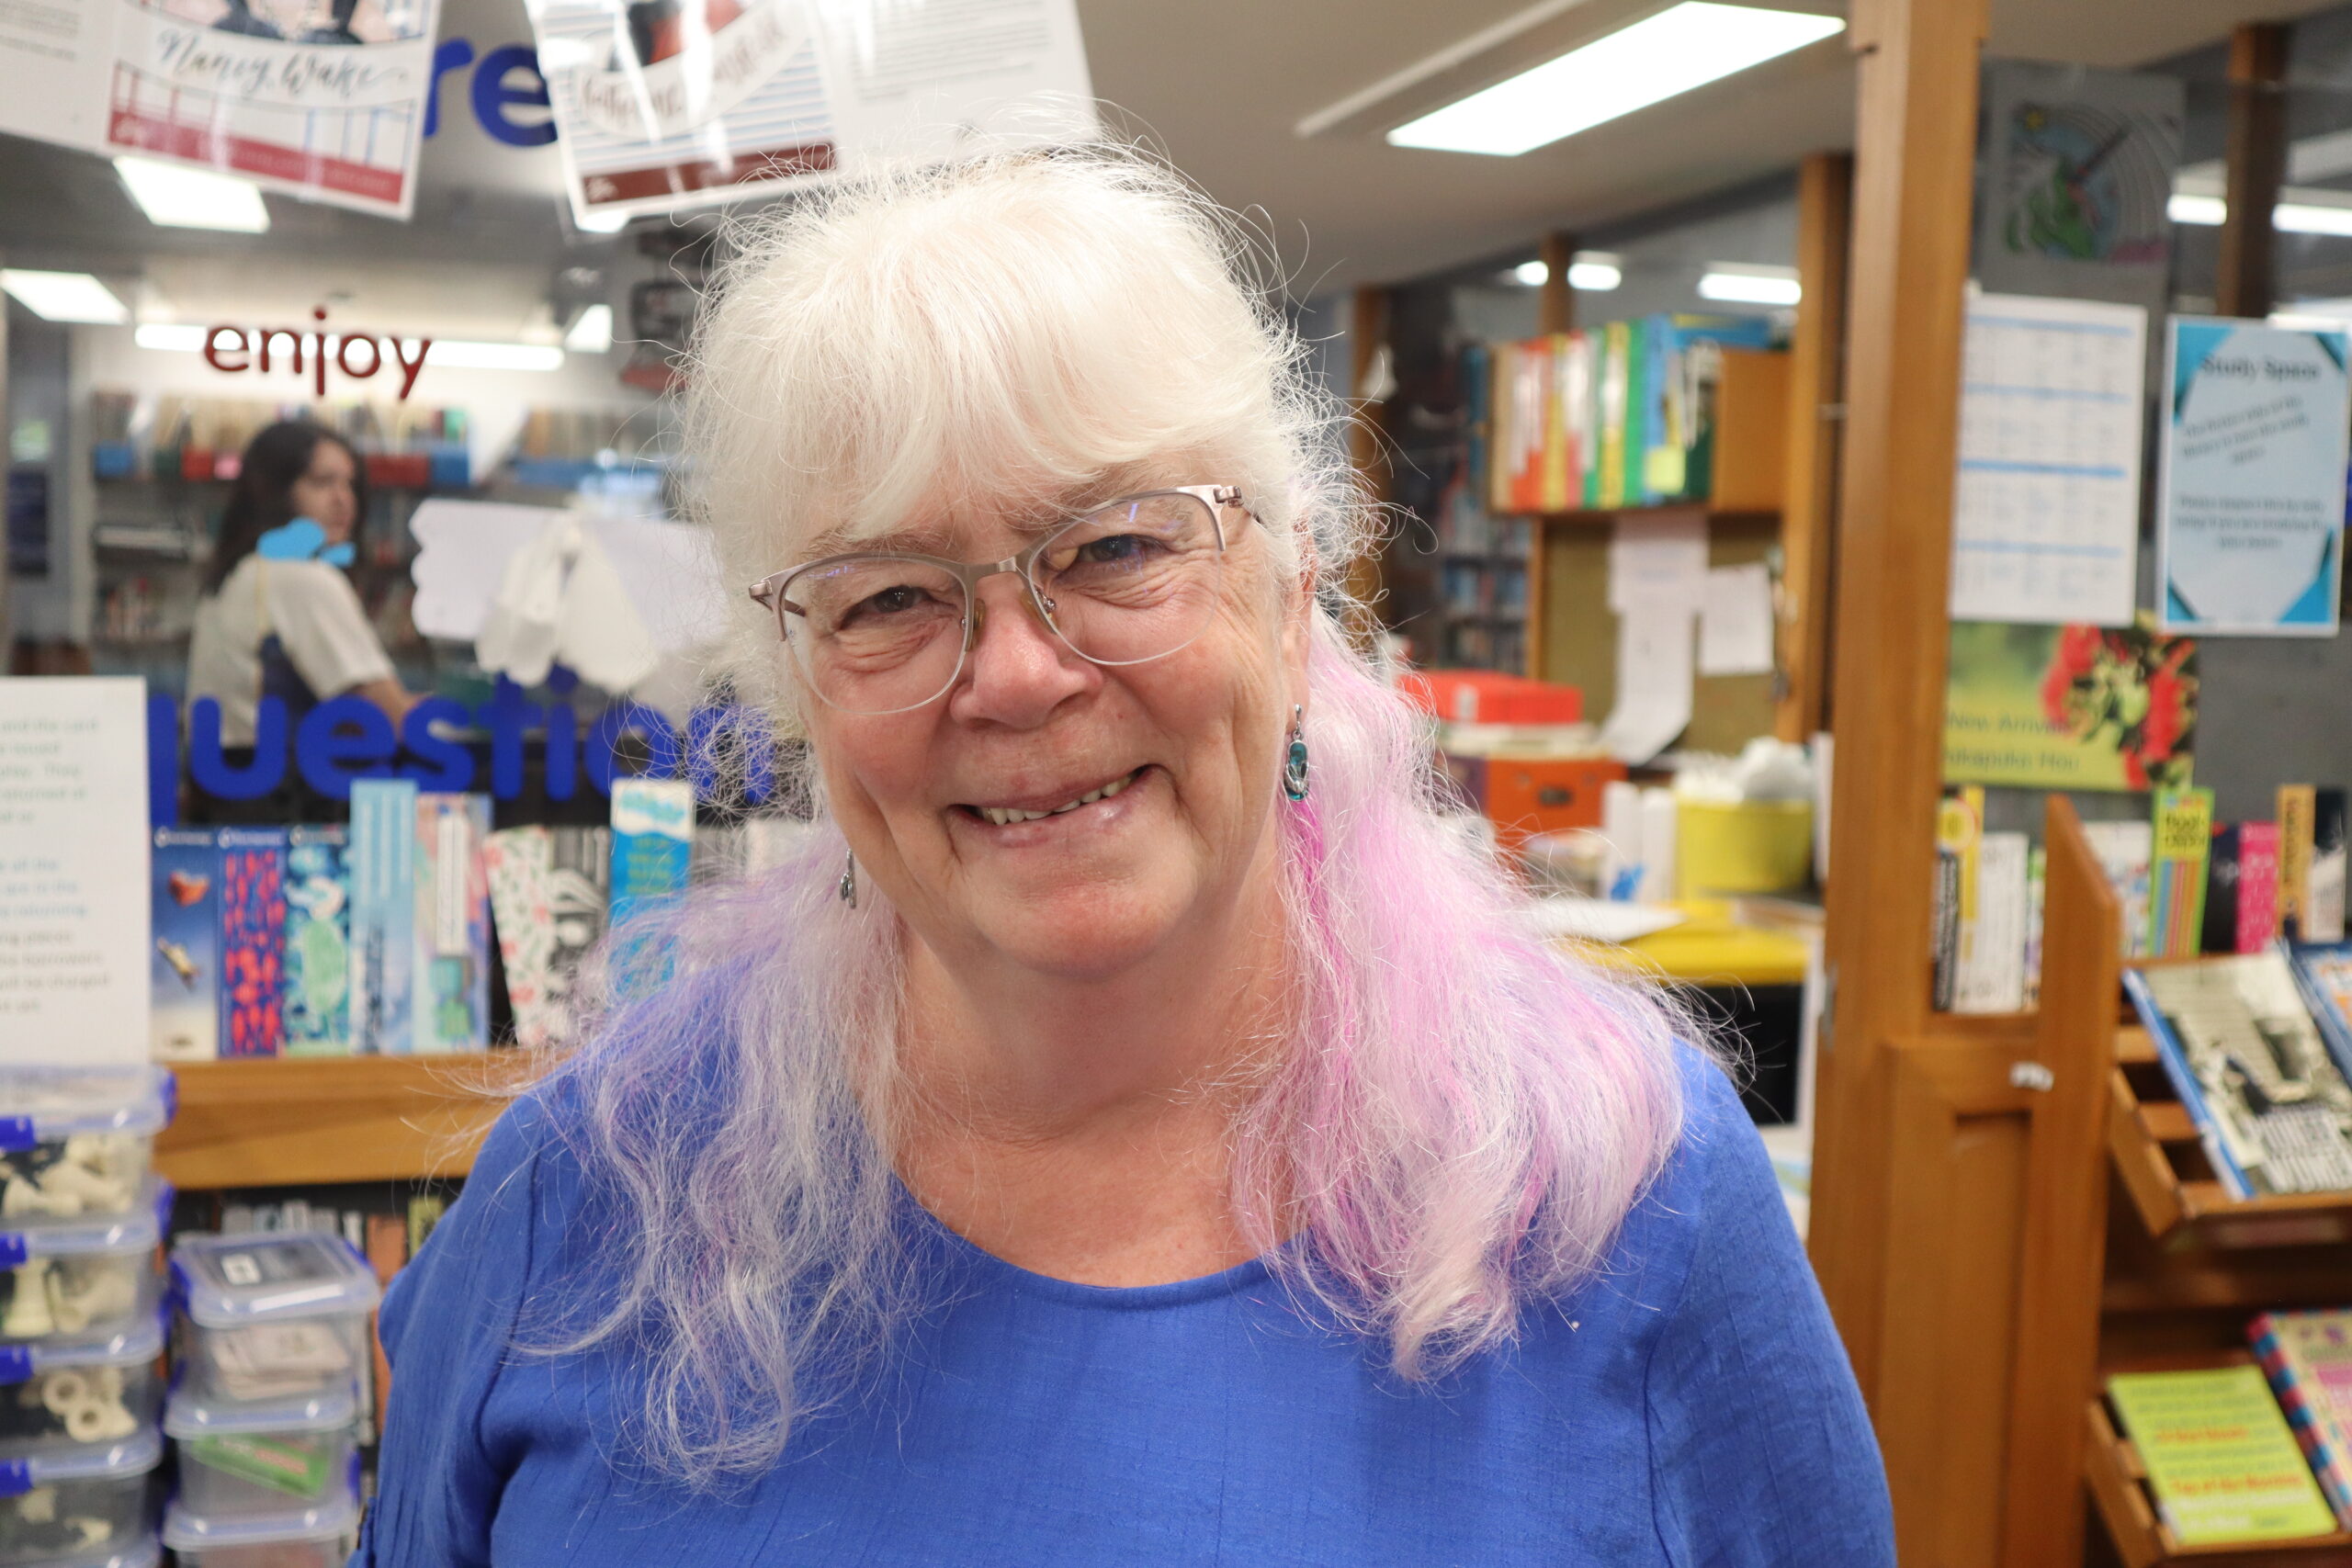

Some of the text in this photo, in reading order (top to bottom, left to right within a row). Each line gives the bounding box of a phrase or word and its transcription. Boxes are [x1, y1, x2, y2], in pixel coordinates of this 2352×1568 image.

[158, 28, 410, 96] Nancy Wake
[204, 306, 432, 400] enjoy
[2202, 355, 2318, 381] Study Space
[1949, 711, 2072, 736] New Arrivals
[2041, 750, 2080, 772] Hou
